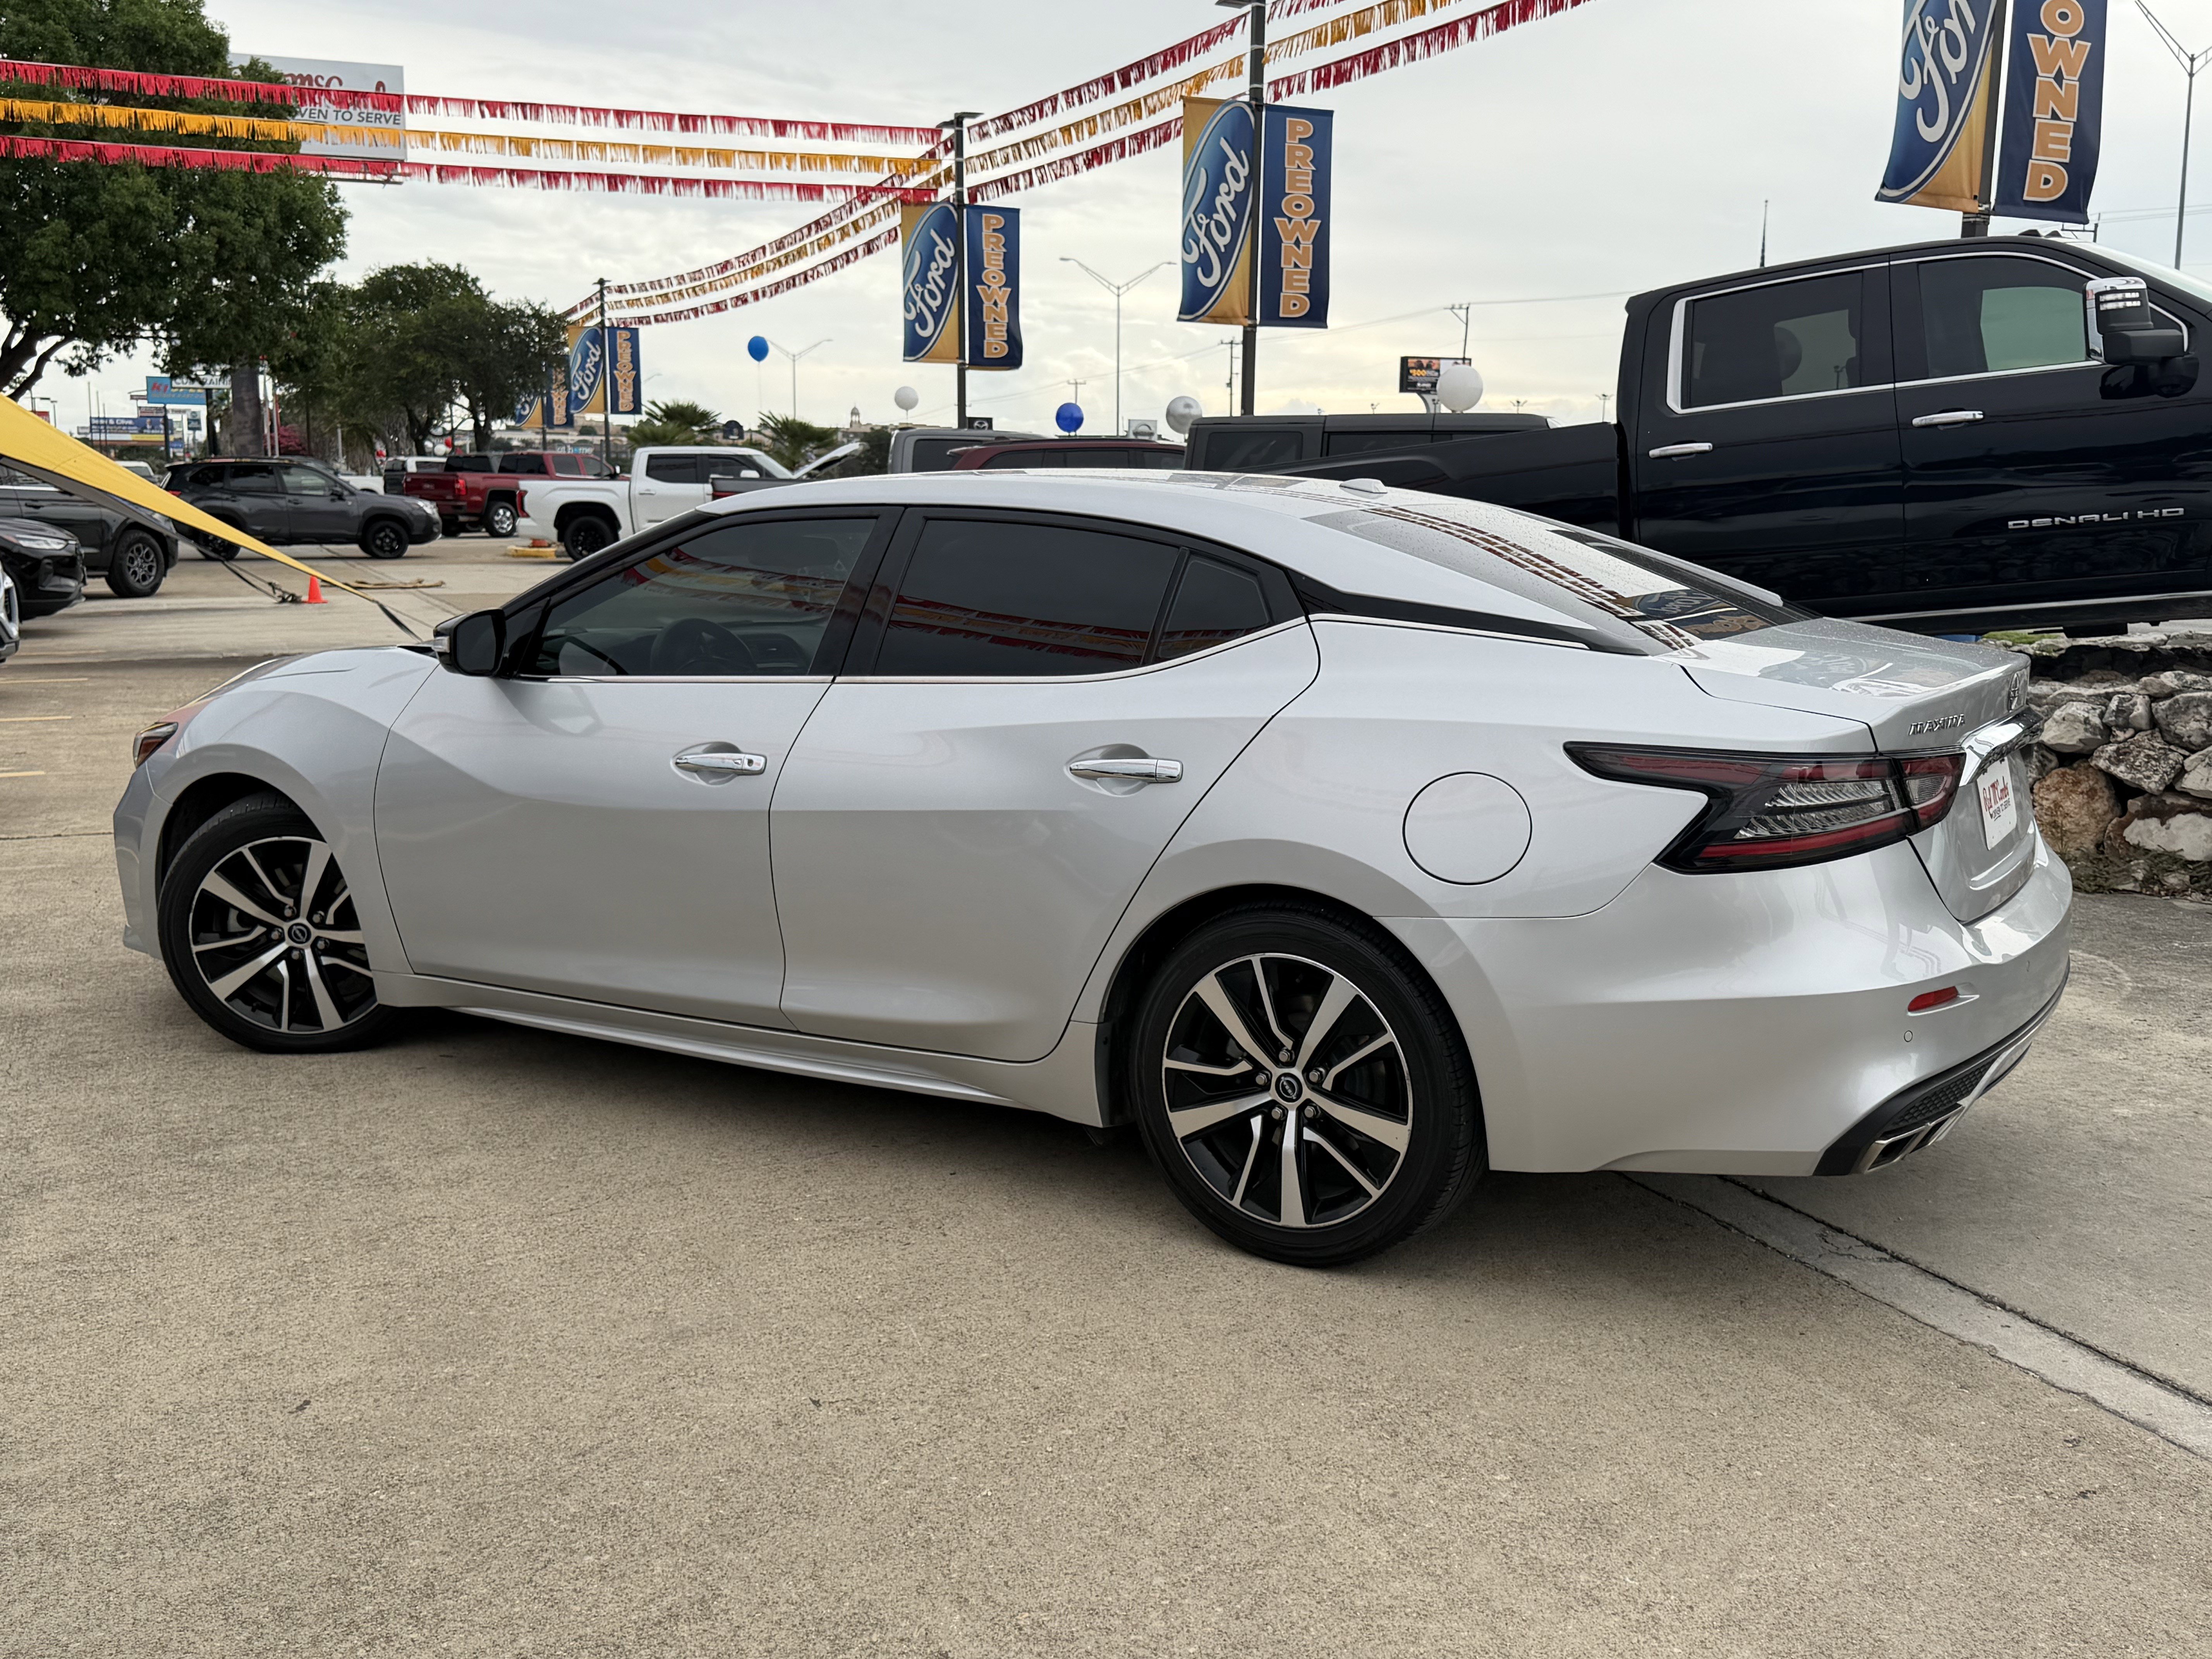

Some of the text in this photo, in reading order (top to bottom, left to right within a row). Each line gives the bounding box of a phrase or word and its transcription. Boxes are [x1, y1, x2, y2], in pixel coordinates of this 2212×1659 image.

[299, 107, 402, 125] VEN TO SERVE
[2023, 0, 2091, 202] OWNED
[1182, 137, 1250, 287] Ford
[1273, 117, 1321, 318] PREOWNED
[904, 229, 955, 338] Ford
[976, 213, 1012, 358] PREOWNED
[572, 340, 601, 400] Ford
[614, 330, 636, 412] PREOWNED
[2008, 507, 2185, 529] DENALI HD
[1908, 713, 1965, 736] MAXIMA
